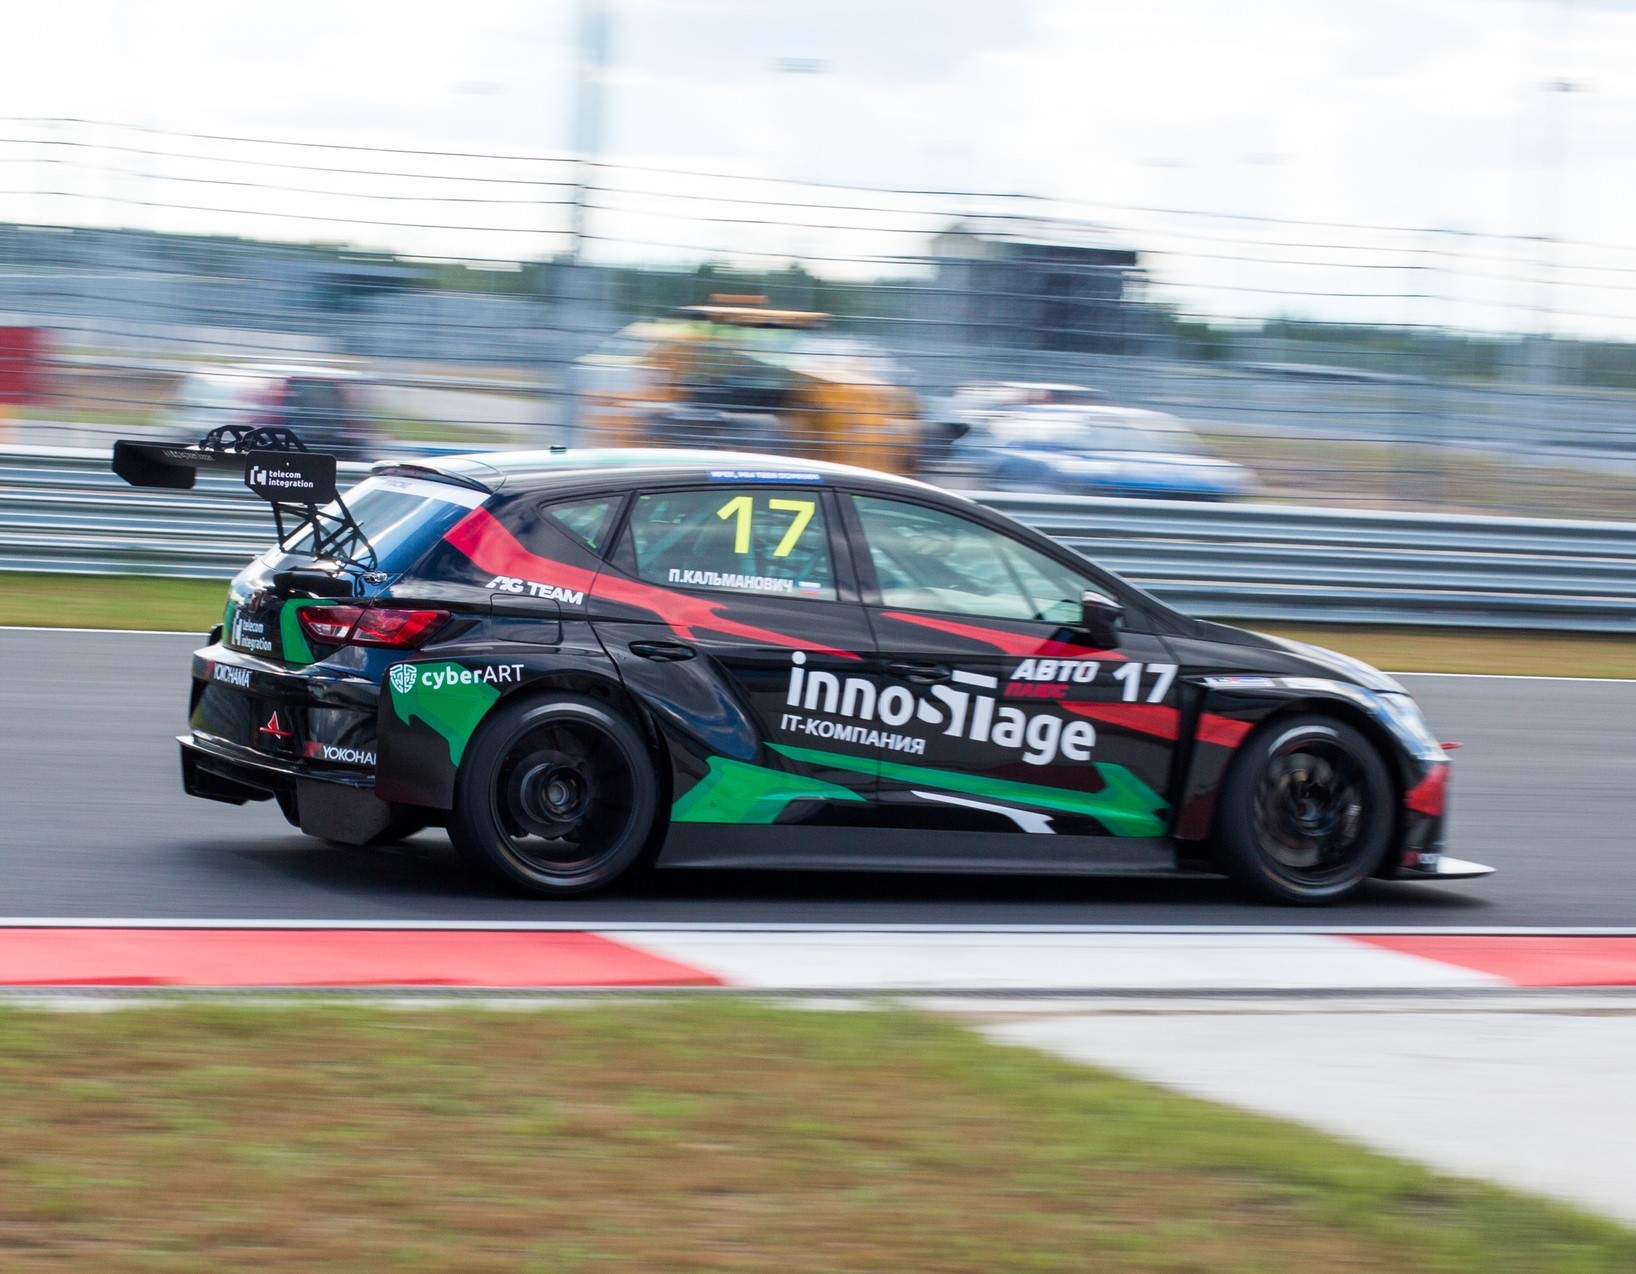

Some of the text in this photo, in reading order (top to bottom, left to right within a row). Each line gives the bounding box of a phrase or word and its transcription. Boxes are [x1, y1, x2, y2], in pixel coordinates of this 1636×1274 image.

[268, 478, 314, 489] integration
[269, 470, 301, 479] telecom
[716, 496, 815, 557] 17
[527, 581, 584, 605] TEAM
[668, 568, 794, 593] П.КАЛЬМАНОВИЧ
[241, 634, 272, 651] integration
[213, 662, 252, 688] YOKOHAMA
[421, 664, 524, 690] cyberART
[1009, 658, 1100, 683] АВТО
[1112, 662, 1179, 704] 17
[322, 745, 377, 766] YOKOHA
